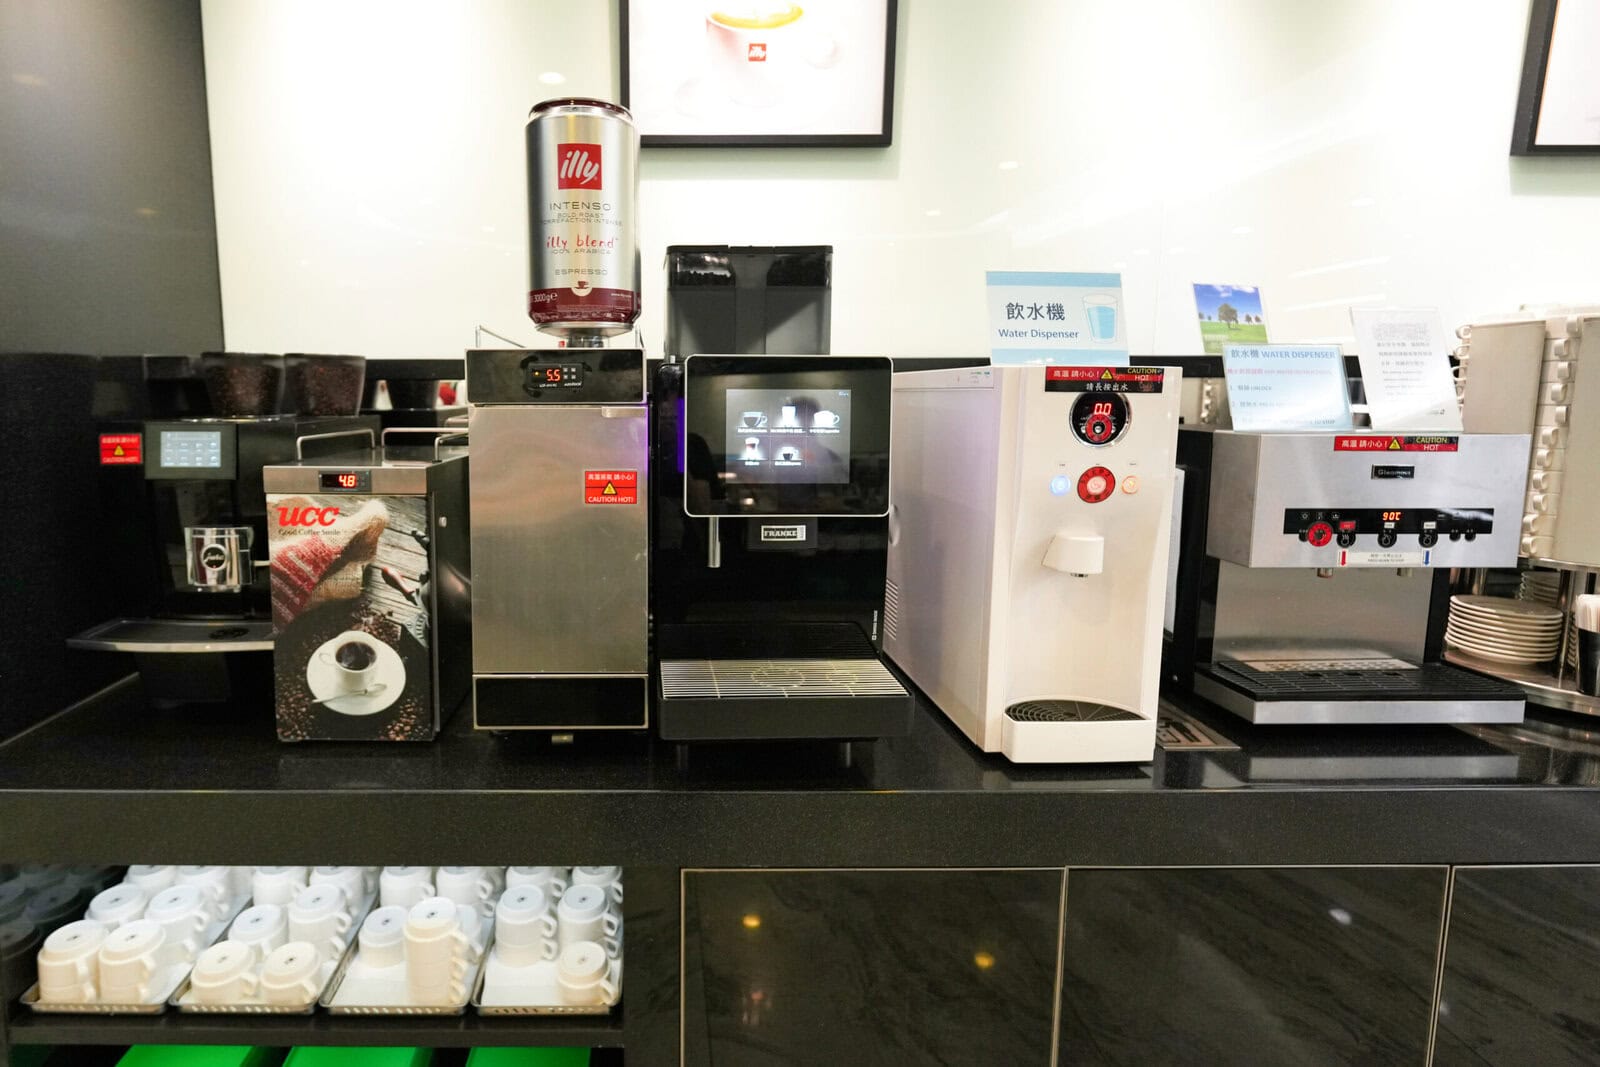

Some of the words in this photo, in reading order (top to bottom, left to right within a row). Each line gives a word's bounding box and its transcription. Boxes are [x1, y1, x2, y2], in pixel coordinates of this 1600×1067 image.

[560, 150, 600, 184] illy
[549, 201, 611, 211] INTENSO
[546, 235, 568, 249] illy
[576, 234, 614, 248] blend
[554, 268, 608, 276] ESPRESSO
[1005, 302, 1066, 321] 飲水機
[998, 329, 1028, 338] Water
[1030, 329, 1080, 340] Dispenser
